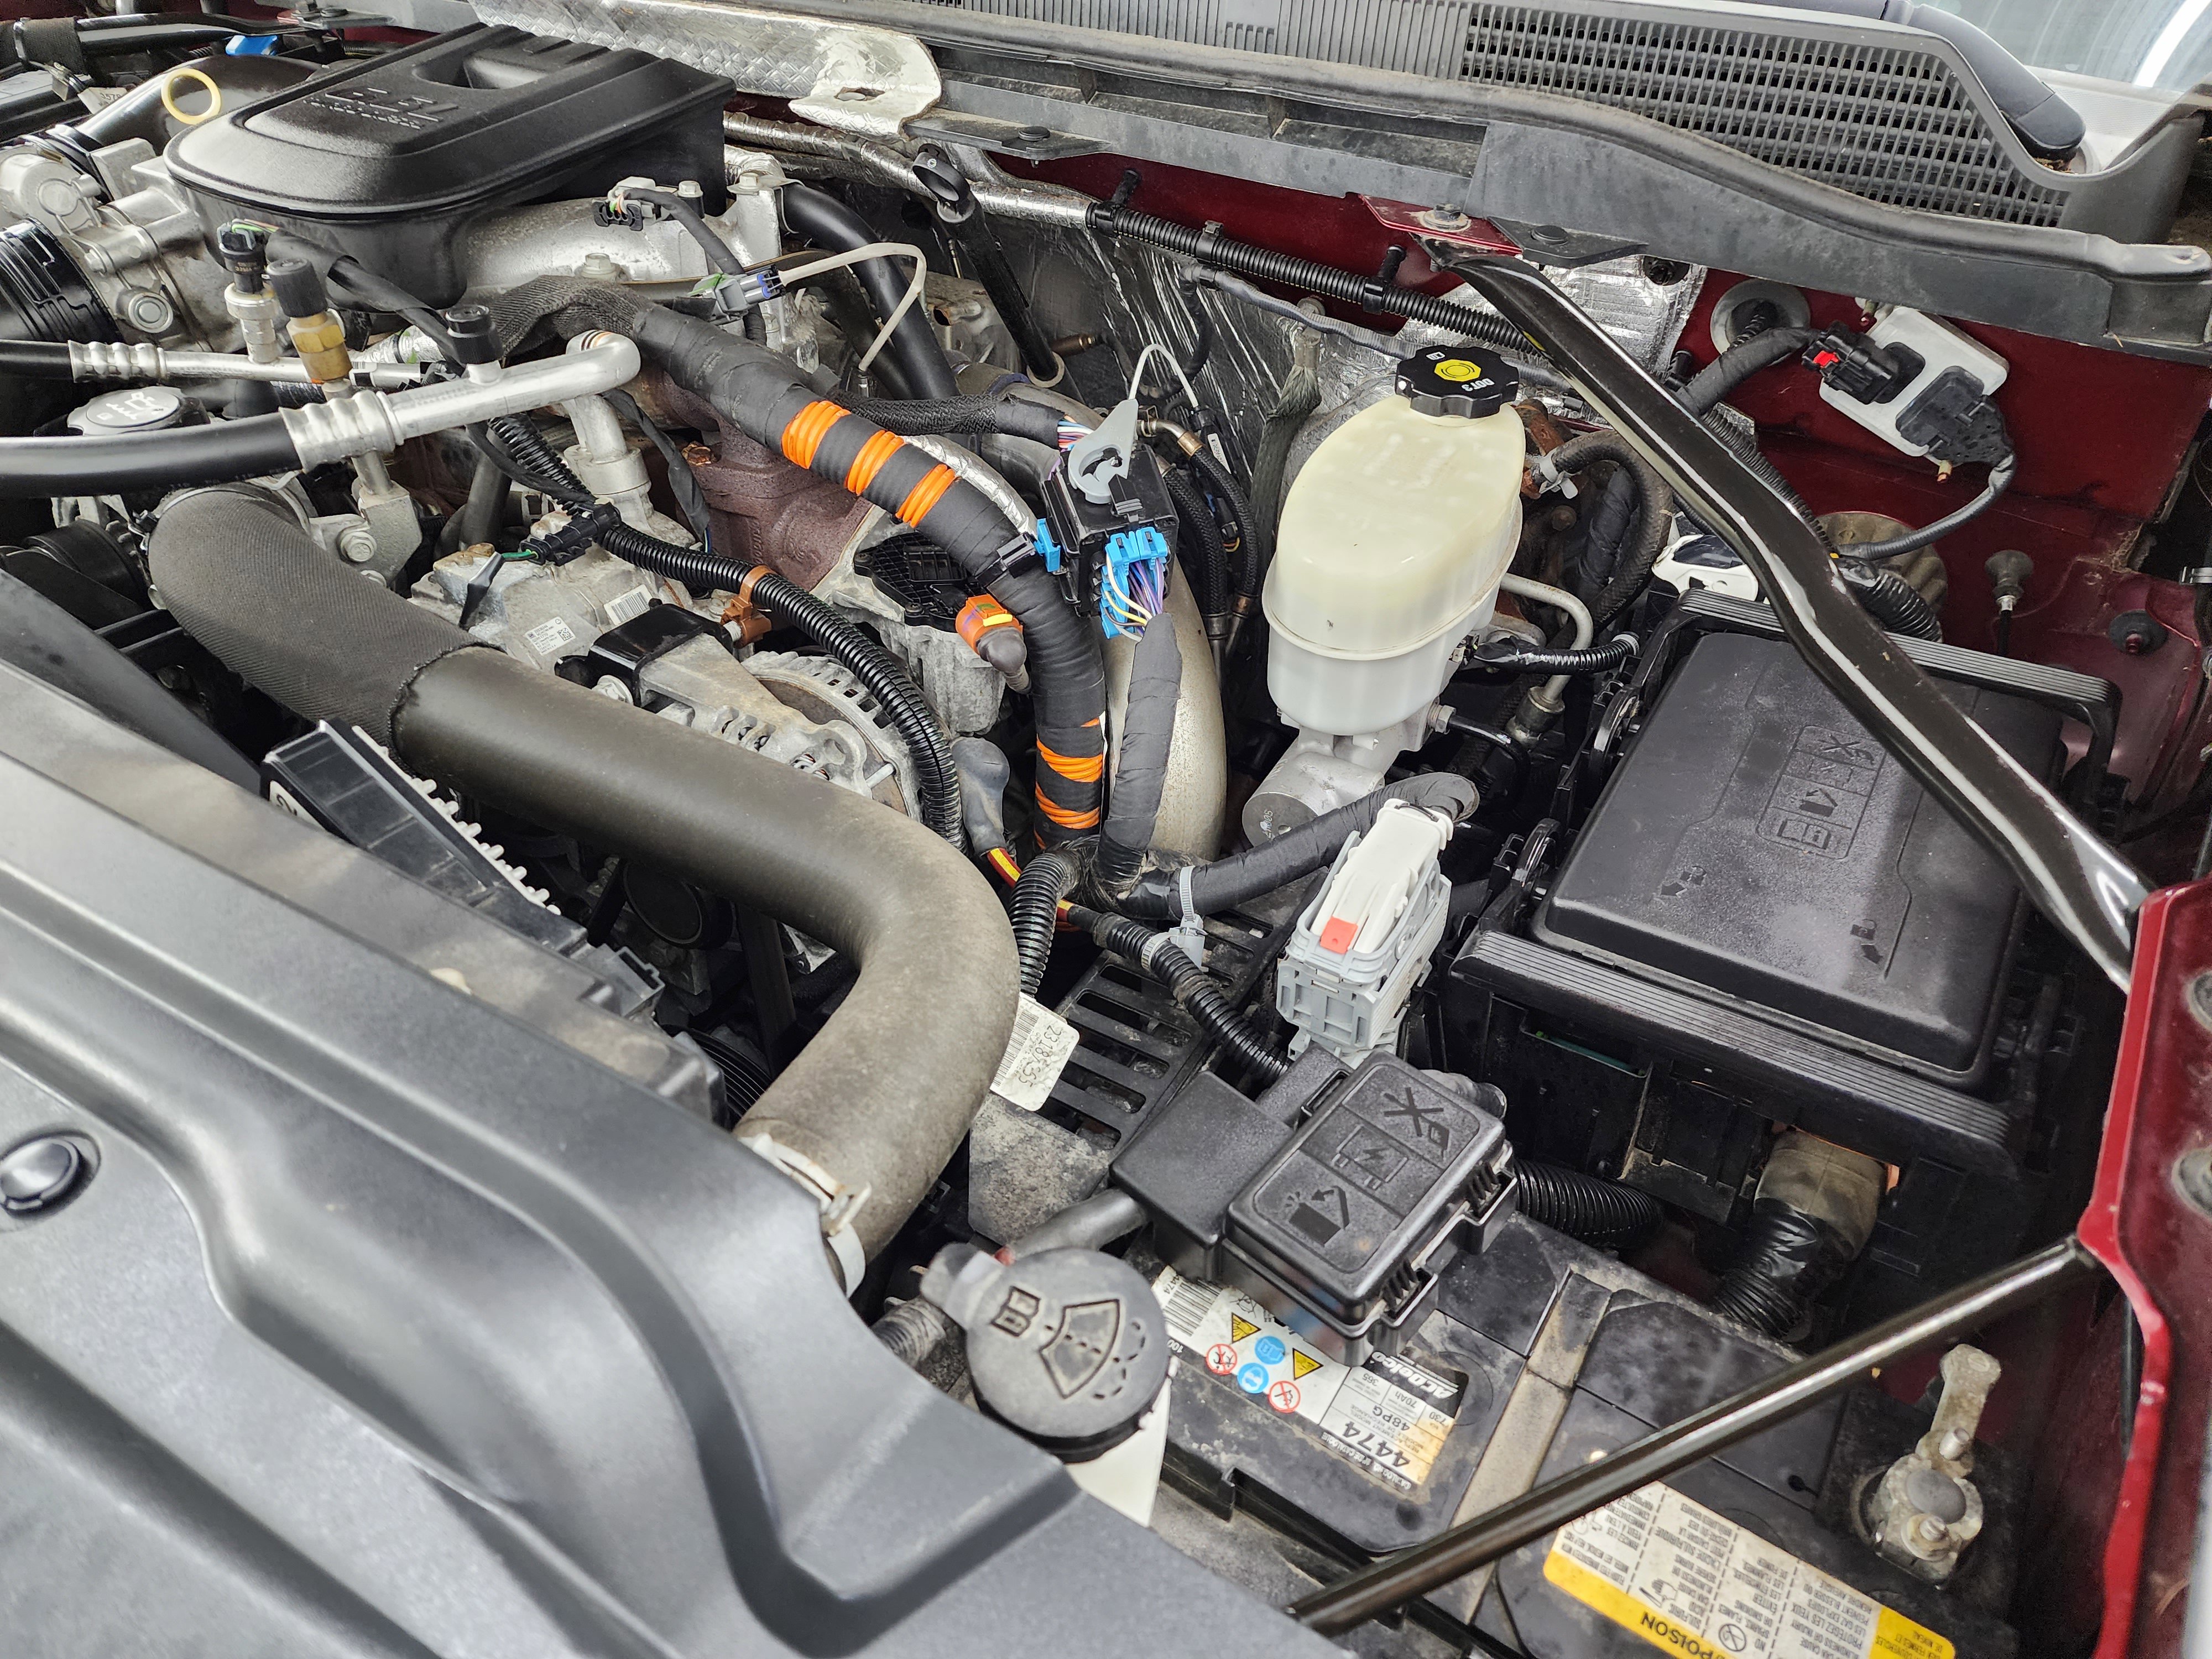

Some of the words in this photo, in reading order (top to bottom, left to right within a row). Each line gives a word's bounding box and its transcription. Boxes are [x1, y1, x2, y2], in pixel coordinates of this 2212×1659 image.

[1470, 378, 1495, 390] DOT
[1361, 1372, 1378, 1386] 365
[1371, 1352, 1454, 1399] ACDelco
[1395, 1391, 1417, 1408] 70Ah
[1350, 1404, 1385, 1427] RECHANGE
[1350, 1408, 1371, 1425] MODEL
[1372, 1405, 1410, 1431] 48PG
[1428, 1411, 1446, 1426] 730
[1321, 1432, 1355, 1456] CATALOGUE
[1342, 1421, 1410, 1467] 4474
[1372, 1422, 1419, 1453] REPLACEMENT
[1383, 1468, 1411, 1490] CATALOG
[1606, 1526, 1618, 1537] LES
[1626, 1526, 1641, 1541] YEUX
[1678, 1526, 1687, 1535] LA
[1655, 1526, 1695, 1556] SULFURIQUE
[1687, 1533, 1709, 1550] CAUSER
[1757, 1558, 1778, 1574] FUMER
[1778, 1568, 1788, 1580] DE
[1681, 1572, 1713, 1594] BLINDNESS
[1695, 1566, 1717, 1584] SEVERE
[1772, 1578, 1785, 1589] LES
[1677, 1582, 1696, 1598] CAUSE
[1768, 1588, 1781, 1600] LES
[1803, 1583, 1813, 1595] OU
[1697, 1593, 1709, 1606] CAN
[1752, 1593, 1777, 1615] ÉVITER
[1813, 1589, 1841, 1610] BLESSER
[1668, 1603, 1702, 1629] SULFURIC
[1688, 1601, 1706, 1617] ACID
[1718, 1604, 1741, 1623] FLAMES
[1734, 1600, 1763, 1621] SMOKING
[1791, 1602, 1809, 1620] YEUX
[1807, 1598, 1840, 1623] EXPLOSIFS
[1841, 1606, 1869, 1626] PEUVENT
[1763, 1616, 1773, 1627] OR
[1791, 1621, 1813, 1637] INJURY
[1811, 1613, 1825, 1629] LES
[1840, 1616, 1853, 1630] GAZ
[1641, 1611, 1714, 1659] POISON
[1813, 1632, 1823, 1644] OR
[1825, 1621, 1863, 1650] PROTÉGEZ
[1854, 1624, 1866, 1637] LES
[1754, 1638, 1766, 1652] NO
[1799, 1636, 1820, 1655] CAUSE
